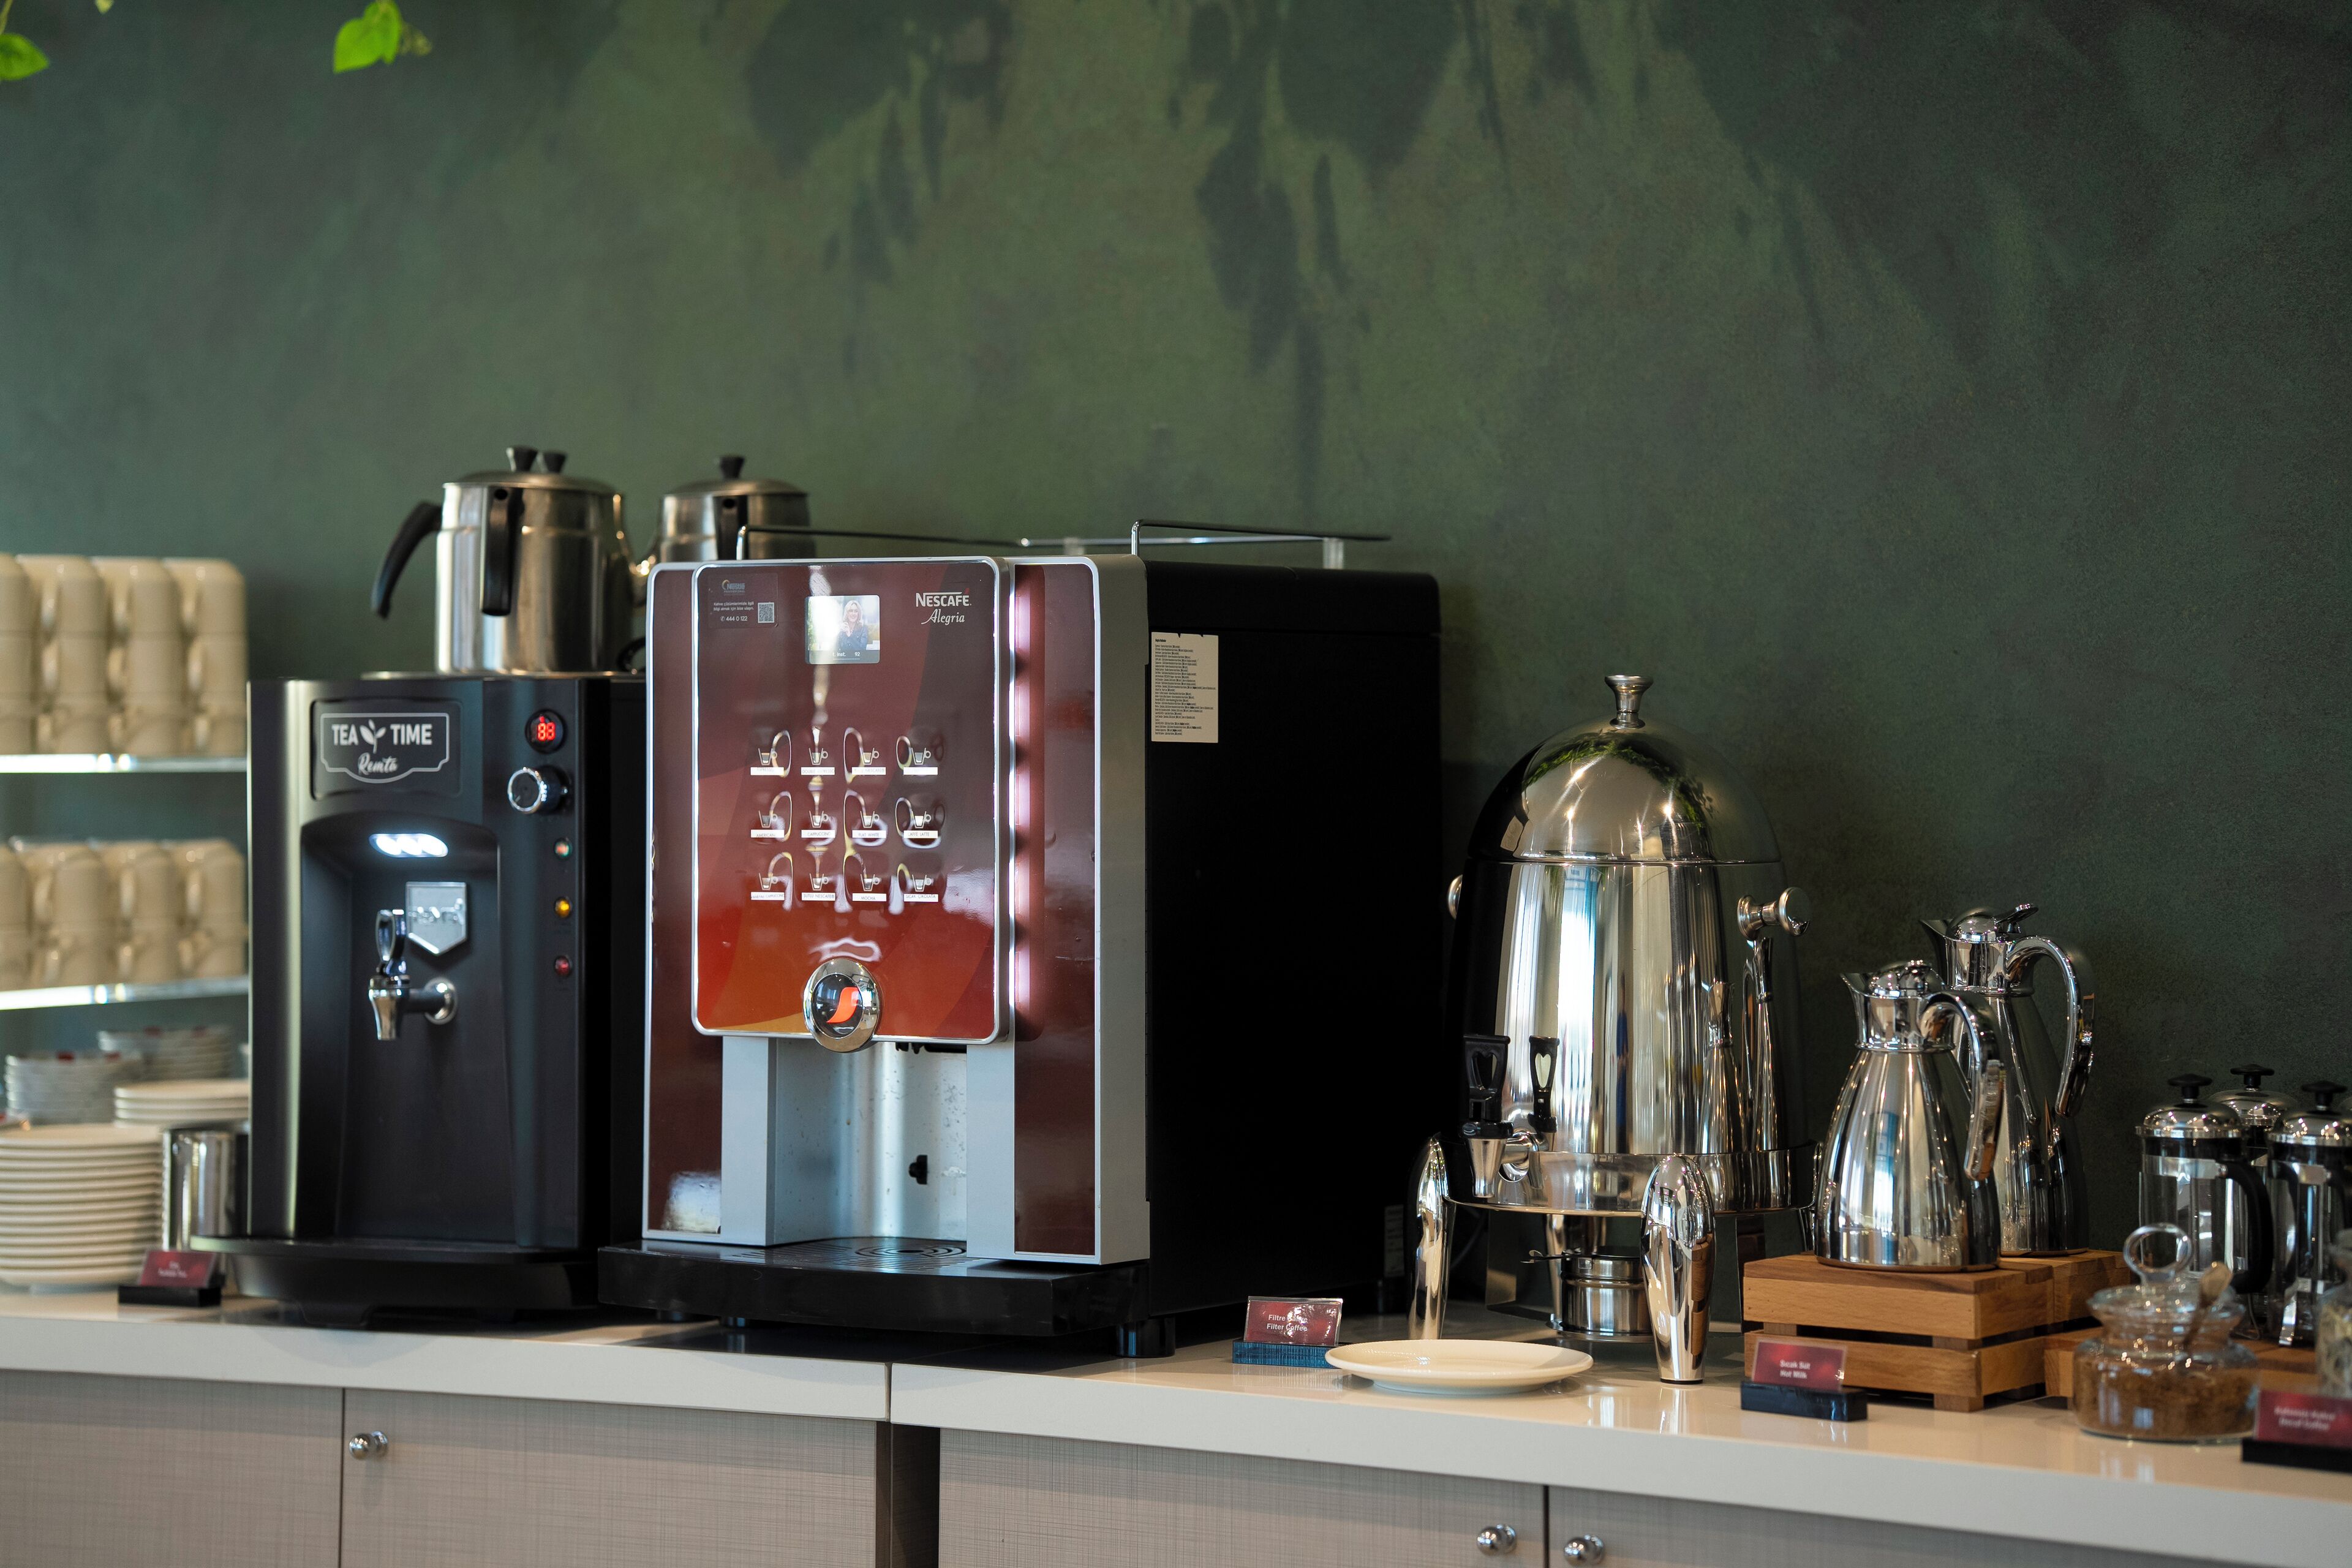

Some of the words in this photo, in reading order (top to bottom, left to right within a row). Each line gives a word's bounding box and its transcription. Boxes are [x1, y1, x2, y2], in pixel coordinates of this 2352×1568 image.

[921, 608, 965, 625] Alegria
[331, 724, 359, 746] TEA
[390, 724, 433, 745] TIME
[358, 752, 399, 775] Remta
[1793, 1371, 1807, 1379] Milk
